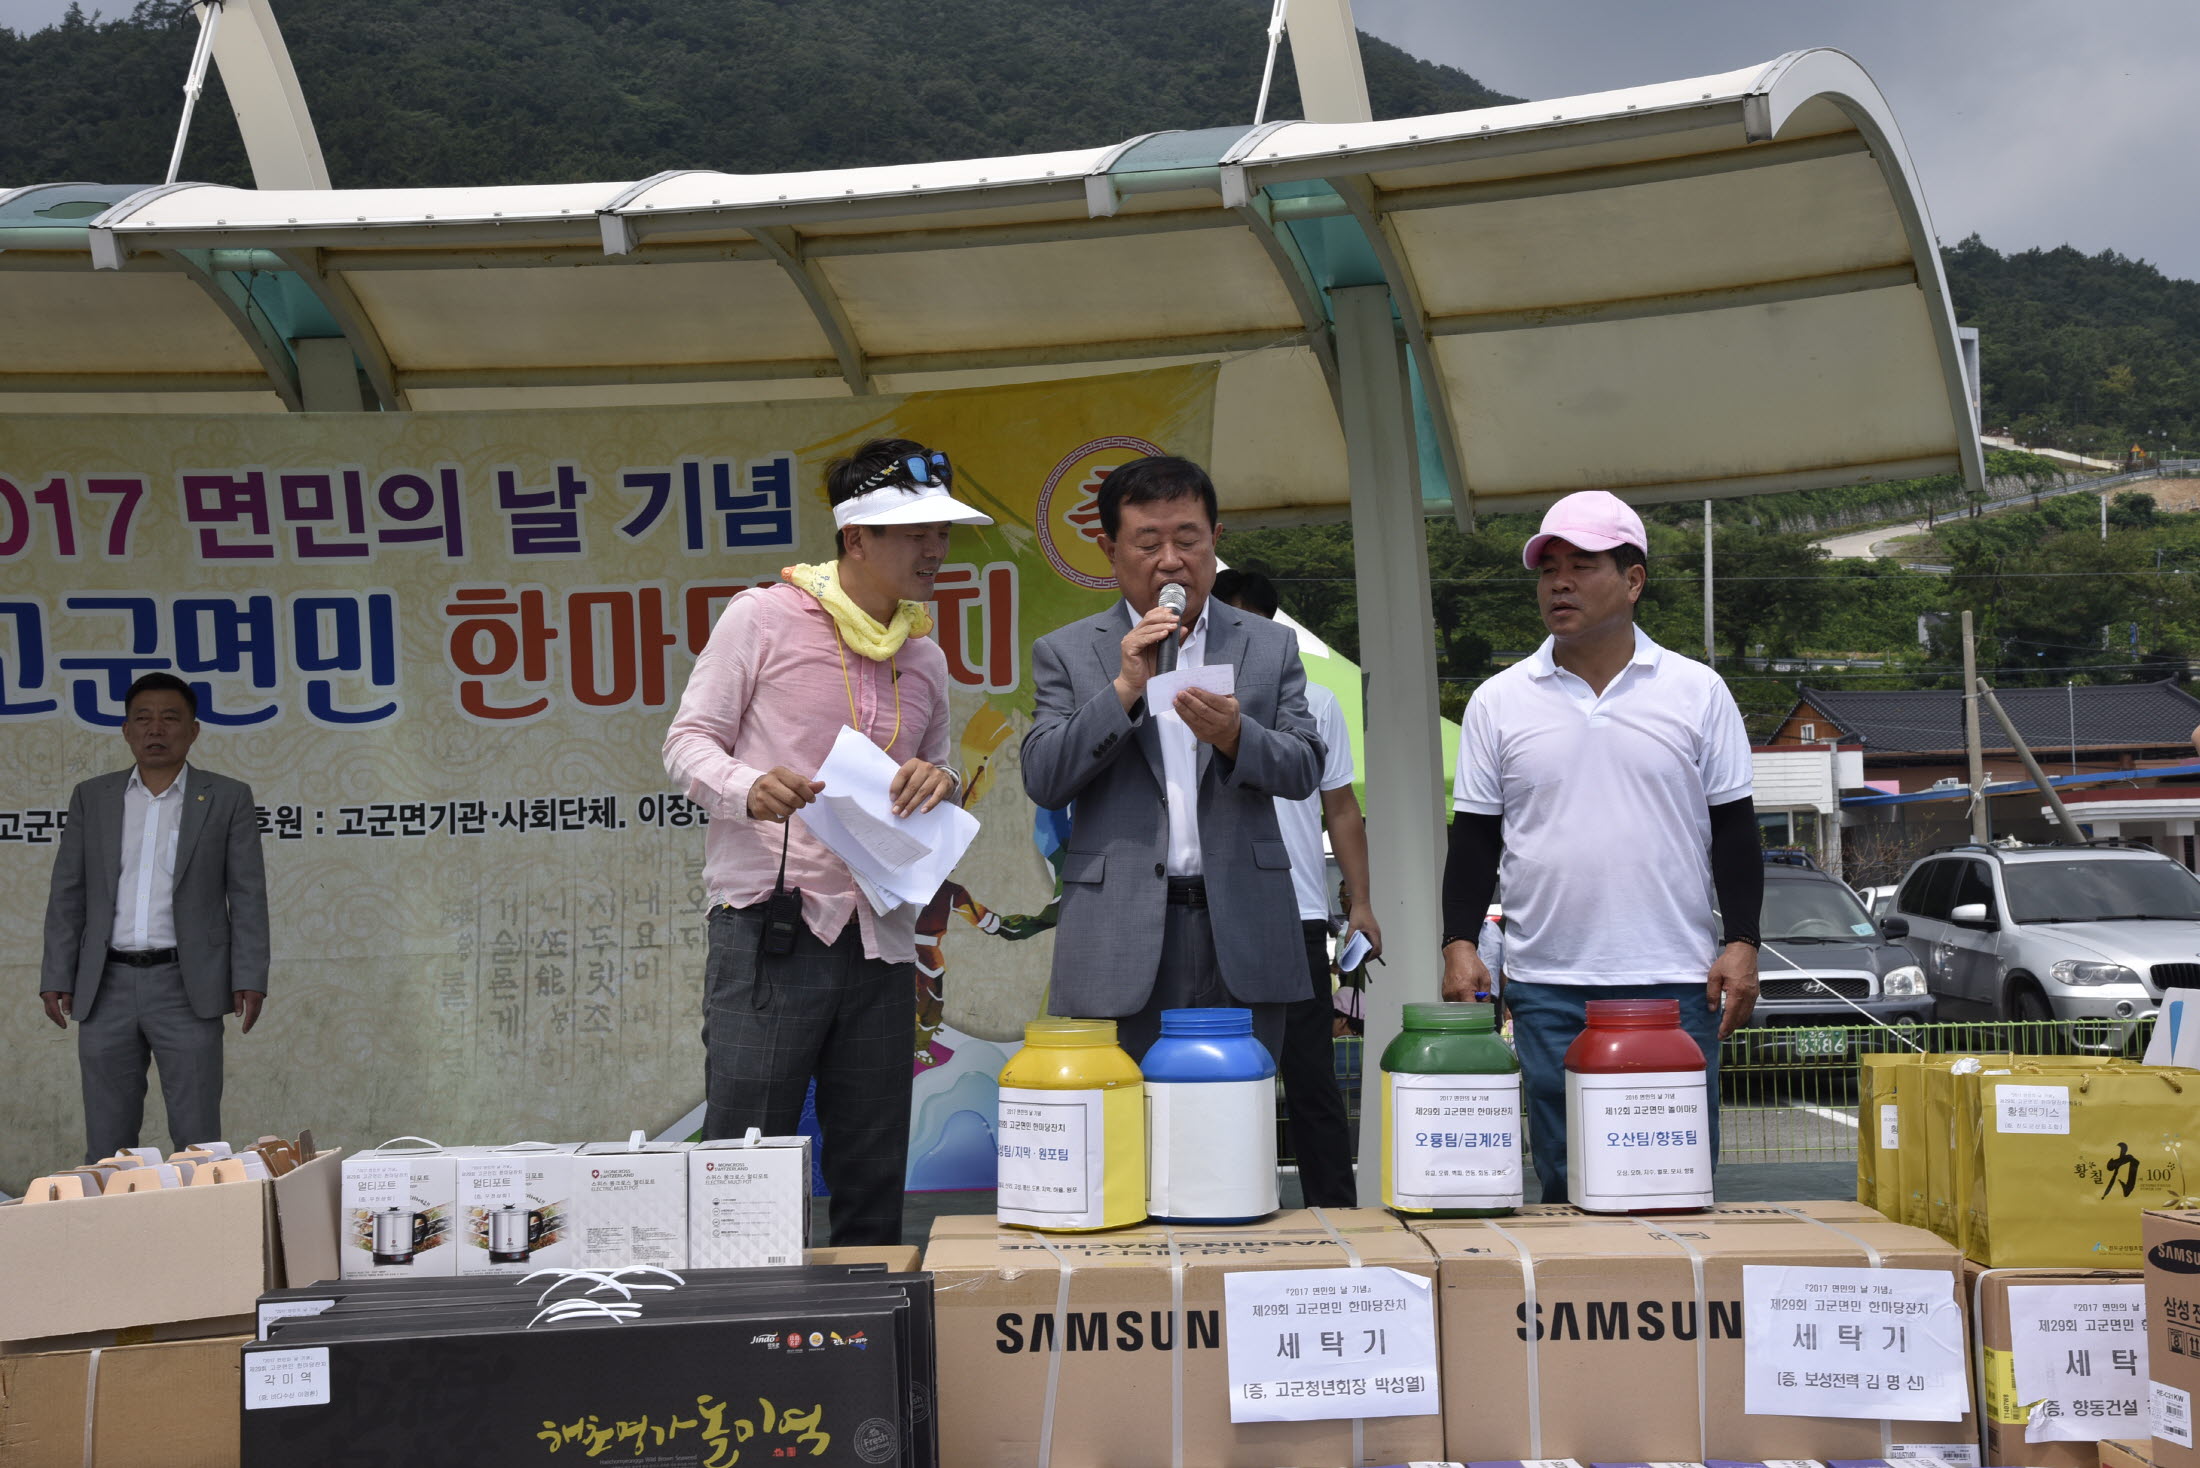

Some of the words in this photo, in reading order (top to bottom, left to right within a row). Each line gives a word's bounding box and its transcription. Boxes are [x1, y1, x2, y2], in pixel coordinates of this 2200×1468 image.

[183, 469, 463, 558] 면민의
[498, 466, 586, 554] 날
[621, 458, 793, 550] 기념
[446, 568, 1012, 720] 한마치
[336, 795, 626, 837] 고군면기관·사회단체.
[1415, 1107, 1440, 1115] 제29회
[1443, 1107, 1474, 1116] 고군면민
[1477, 1107, 1512, 1116] 한마당잔치
[1605, 1107, 1630, 1115] 제12회
[1634, 1105, 1664, 1114] 고군면민
[1415, 1132, 1512, 1148] 오룡팀/금계2팀
[1607, 1130, 1697, 1147] 오산팀/향동팀
[1039, 1148, 1068, 1161] 원포팀
[2147, 1168, 2171, 1181] 100
[358, 1181, 396, 1191] 멀티포트
[473, 1178, 511, 1188] 멀티포트
[1313, 1286, 1336, 1295] 면민의
[1340, 1286, 1348, 1294] 날
[1832, 1284, 1856, 1293] 면민의
[1860, 1285, 1868, 1294] 날
[1252, 1304, 1289, 1317] 제29회
[1296, 1302, 1342, 1315] 고군면민
[1349, 1299, 1406, 1313] 한마당잔치
[1770, 1298, 1807, 1311] 제29회
[1814, 1299, 1861, 1313] 고군면민
[1869, 1300, 1928, 1314] 한마당잔치
[2102, 1303, 2127, 1312] 면민의
[2132, 1303, 2140, 1312] 날
[1516, 1300, 1742, 1342] SAMSUN
[2038, 1319, 2078, 1332] 제29회
[2085, 1319, 2134, 1332] 고군면민
[750, 1335, 776, 1344] Jindo
[996, 1310, 1220, 1354] SAMSUN
[1792, 1323, 1817, 1350] 세
[1838, 1324, 1862, 1351] 탁
[1882, 1326, 1905, 1352] 기
[1277, 1332, 1300, 1359] 세
[1320, 1331, 1344, 1357] 탁
[1363, 1329, 1386, 1355] 기
[2066, 1349, 2091, 1377] 세
[2112, 1349, 2137, 1376] 탁
[264, 1374, 276, 1386] 각
[282, 1373, 293, 1384] 미
[301, 1371, 311, 1383] 역
[1805, 1372, 1859, 1389] 보성전력
[1865, 1374, 1880, 1390] 김
[1887, 1375, 1900, 1391] 명
[1275, 1378, 1366, 1398] 고군청년회장
[2073, 1399, 2138, 1417] 향동건설
[863, 1434, 888, 1446] Fresh
